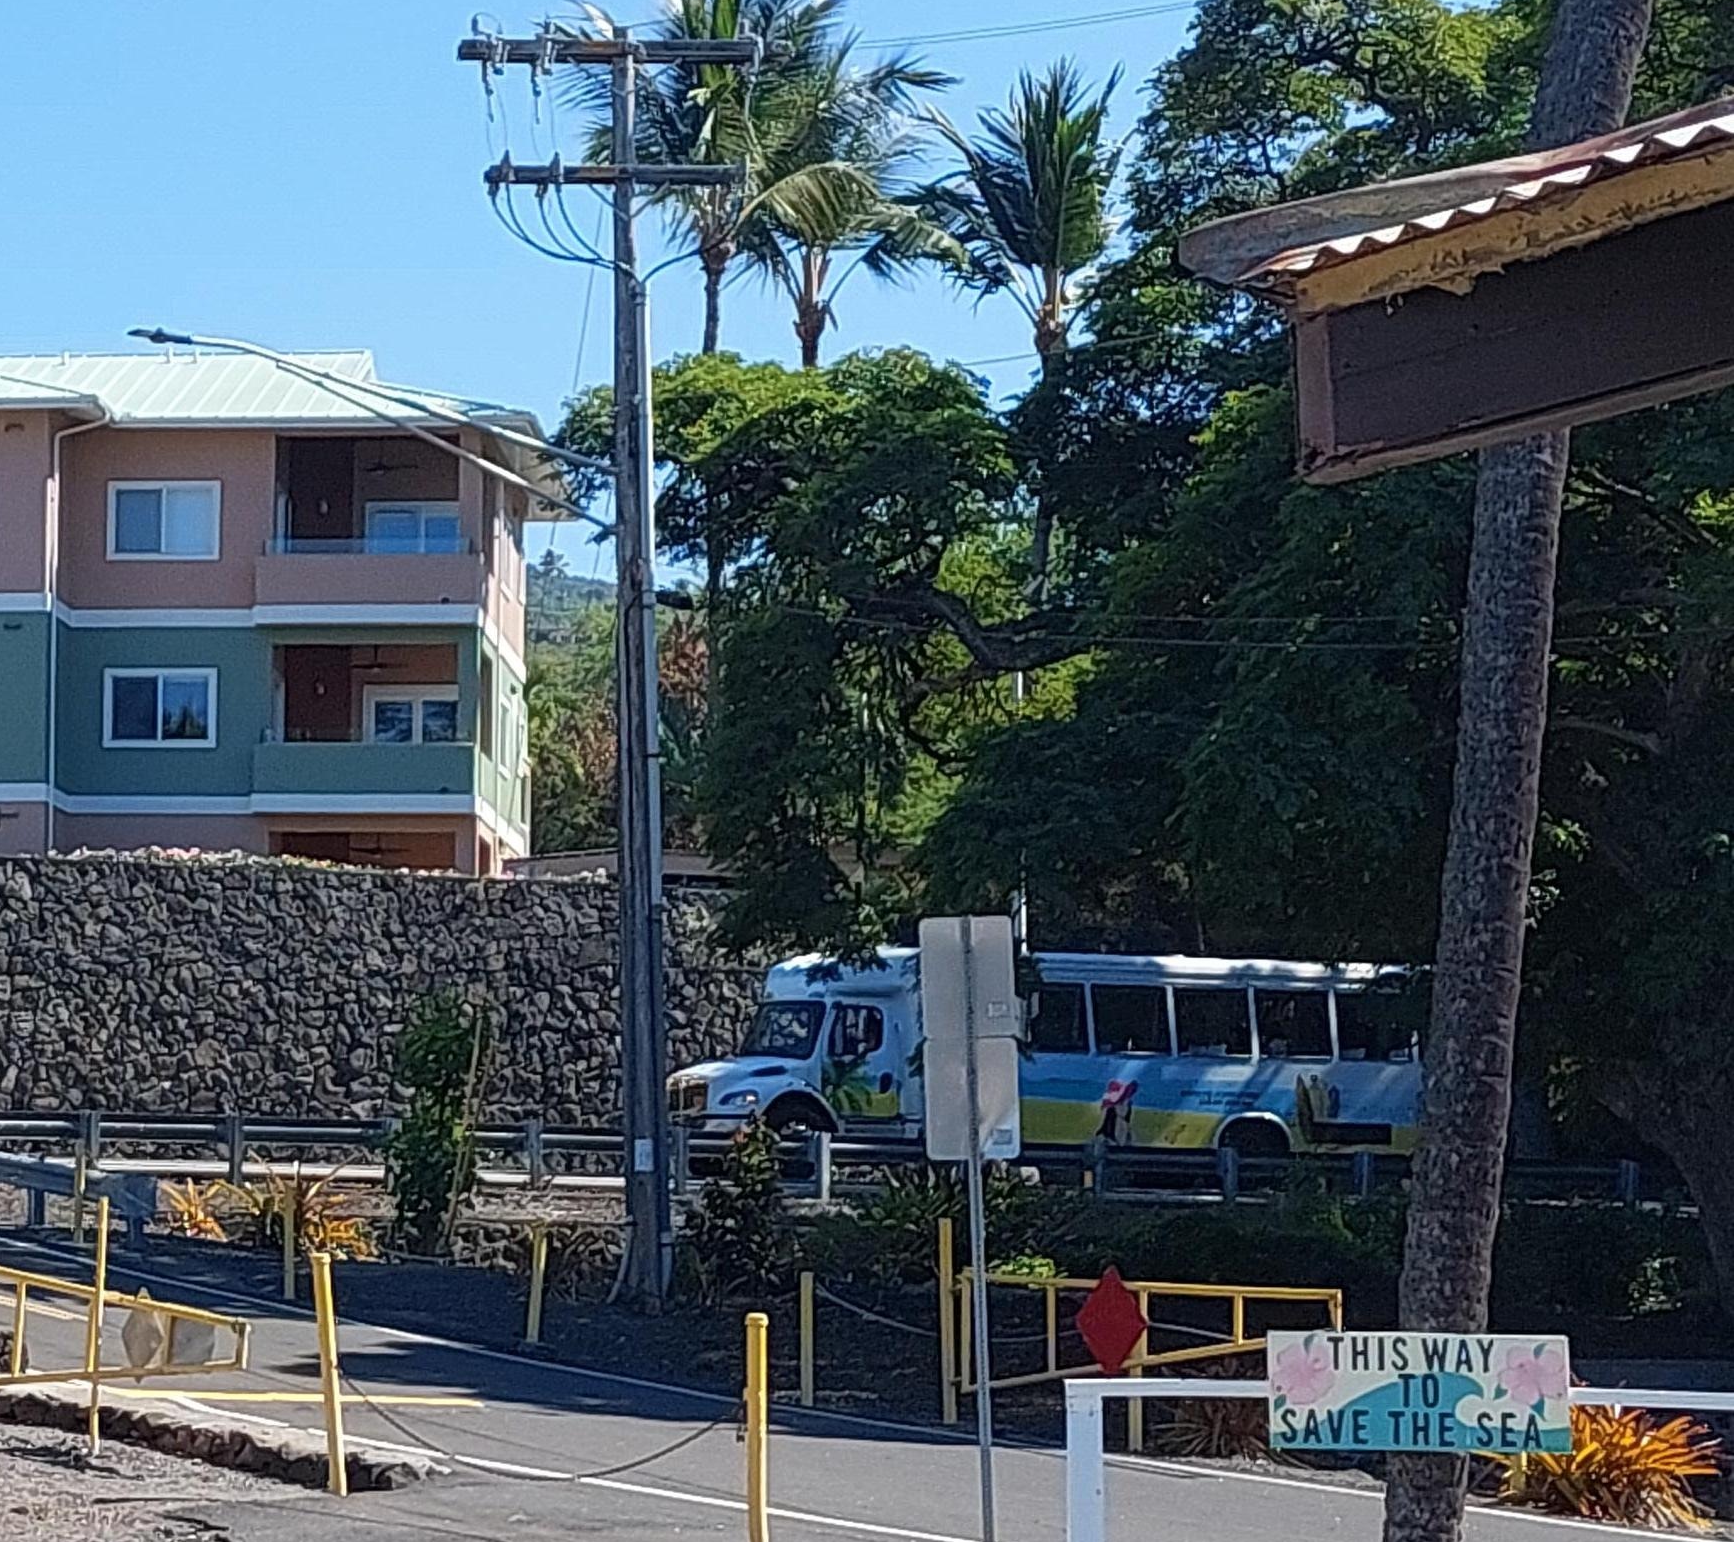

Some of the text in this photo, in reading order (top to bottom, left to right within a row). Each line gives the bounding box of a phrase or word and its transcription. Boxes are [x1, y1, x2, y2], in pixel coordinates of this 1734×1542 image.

[1327, 1336, 1494, 1373] THIS WAY
[1398, 1373, 1440, 1409] TO
[1281, 1409, 1544, 1449] SAVE THE SEA
